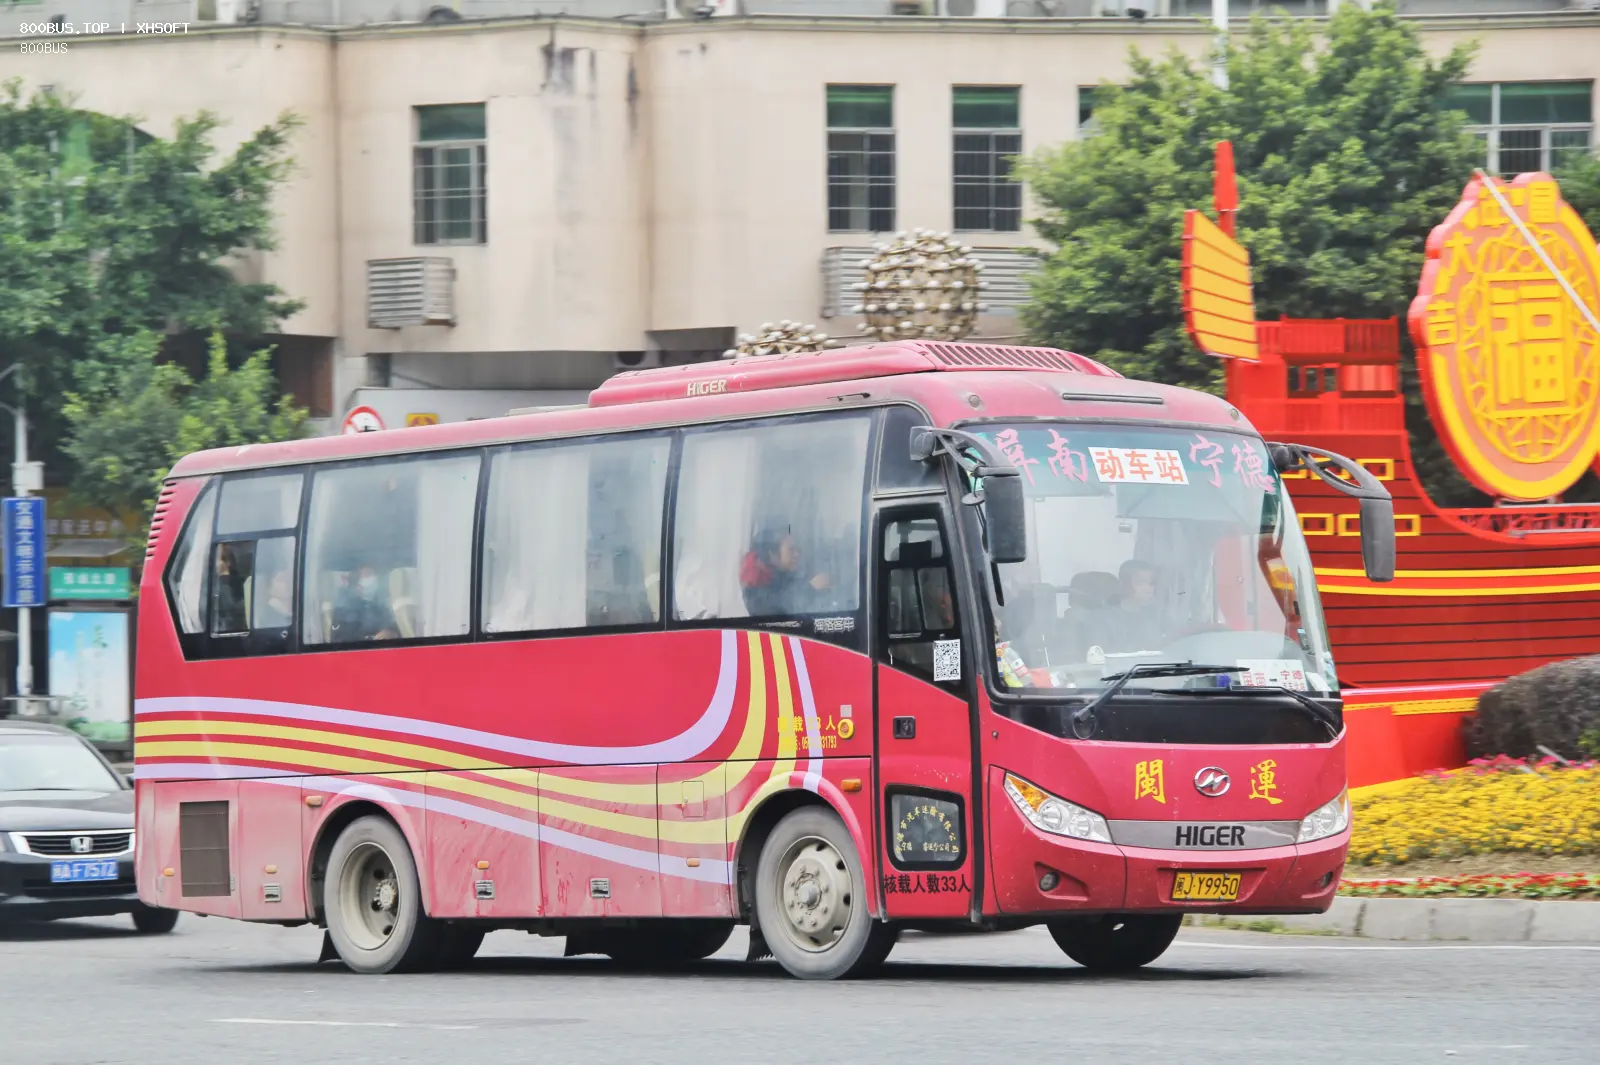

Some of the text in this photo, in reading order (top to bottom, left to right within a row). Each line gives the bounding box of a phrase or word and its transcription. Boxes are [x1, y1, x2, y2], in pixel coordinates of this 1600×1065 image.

[1491, 286, 1565, 404] 福
[686, 379, 727, 396] HIGER
[1095, 449, 1185, 483] 动车站
[1189, 433, 1276, 494] 宁德
[1280, 670, 1303, 680] 宁德
[1175, 825, 1246, 846] HIGER
[884, 873, 972, 893] 核载人数33人
